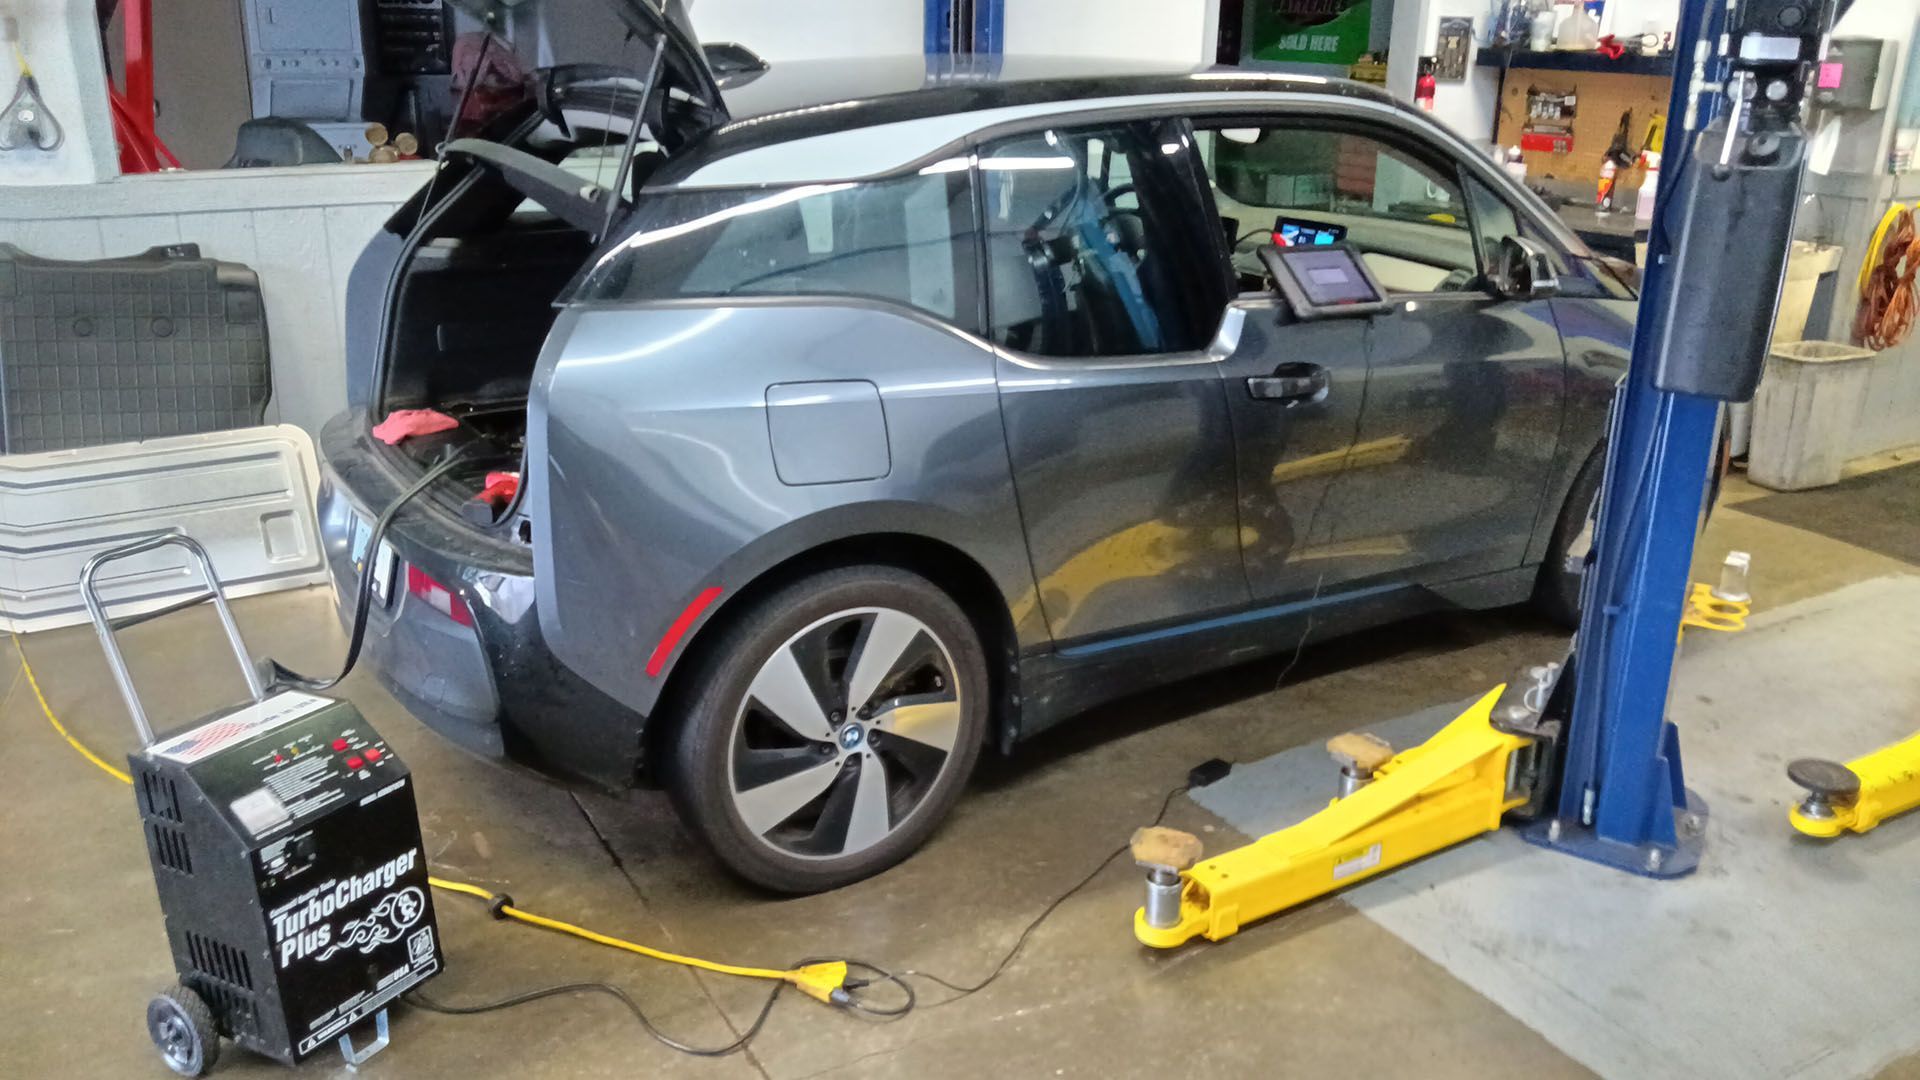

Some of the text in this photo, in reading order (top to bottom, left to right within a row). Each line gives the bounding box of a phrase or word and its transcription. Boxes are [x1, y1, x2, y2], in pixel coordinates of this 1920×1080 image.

[1279, 33, 1340, 53] SOLD HERE
[272, 847, 418, 943] TurboCharger
[280, 923, 332, 969] Plus
